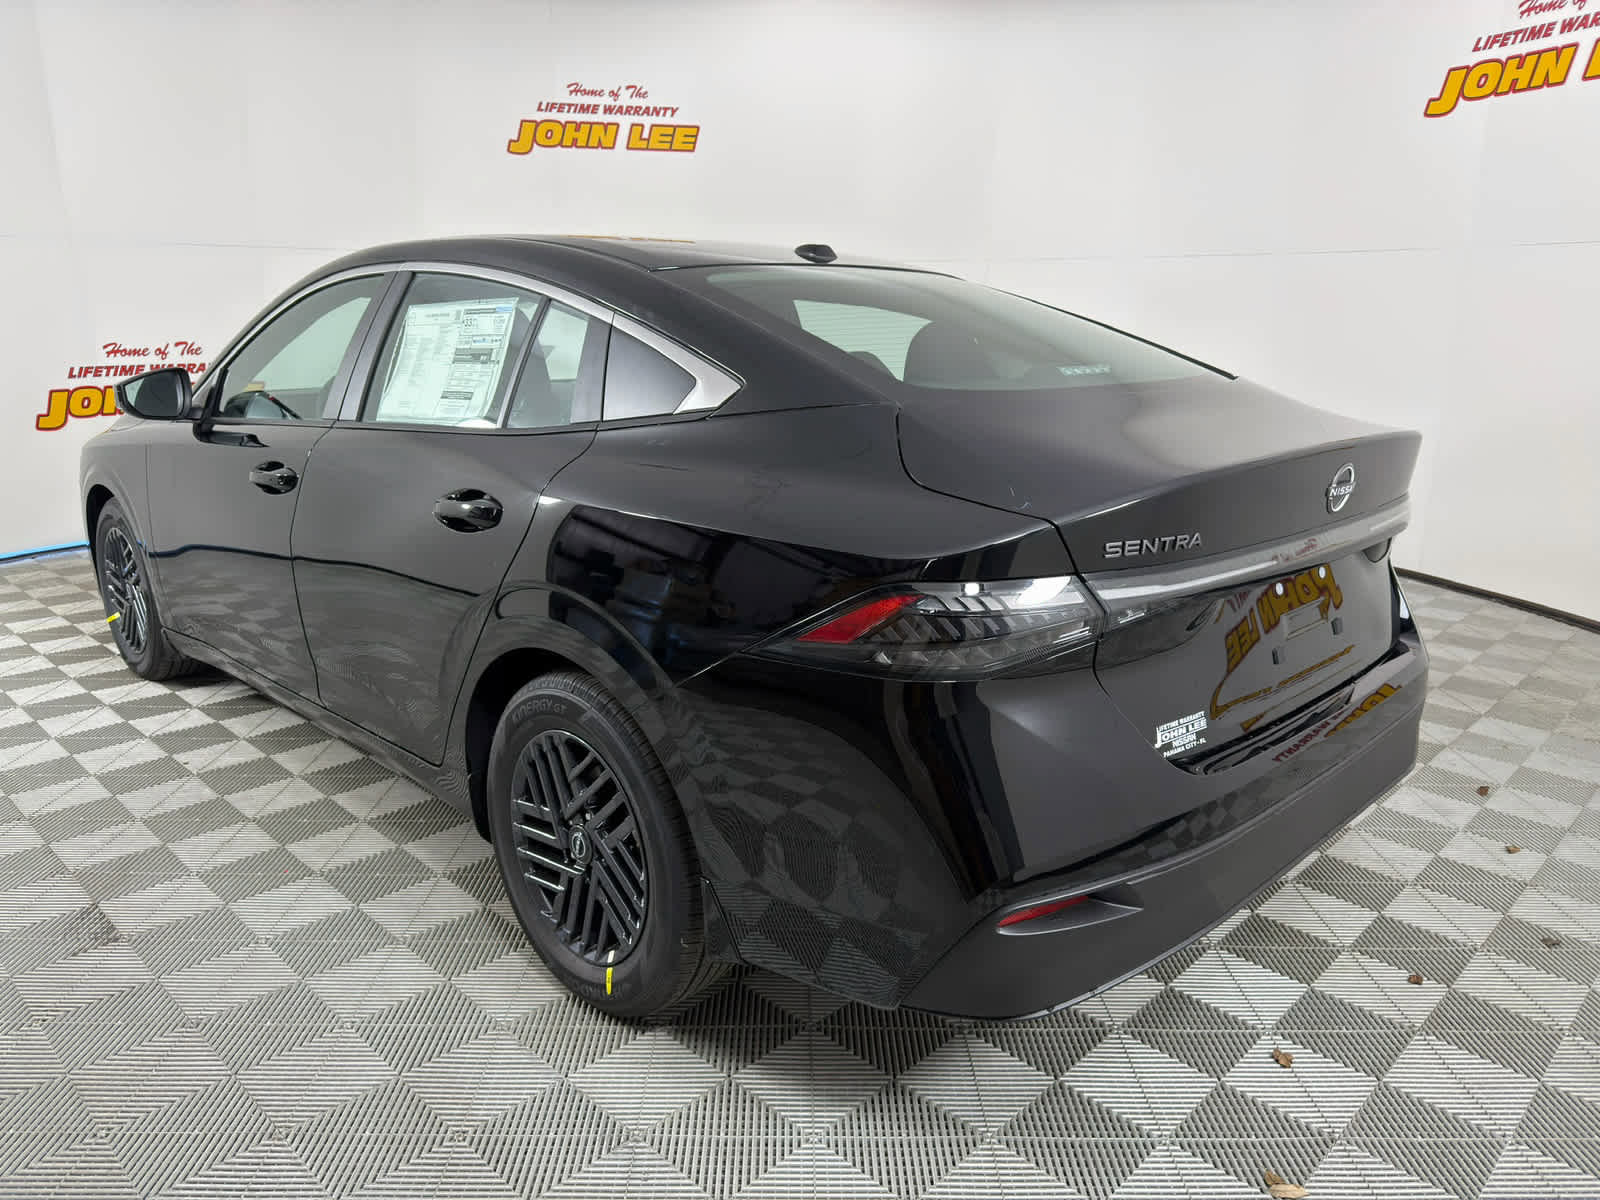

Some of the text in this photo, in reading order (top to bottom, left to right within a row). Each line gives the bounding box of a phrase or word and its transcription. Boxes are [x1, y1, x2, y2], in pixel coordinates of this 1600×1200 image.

[1518, 0, 1568, 19] Home
[1472, 21, 1557, 52] LIFETIME
[1424, 42, 1579, 117] JOHN
[567, 82, 649, 102] Home of The
[536, 101, 679, 118] LIFETIME WARRANTY
[507, 119, 700, 155] JOHN LEE
[102, 341, 203, 360] Home of The
[68, 364, 146, 379] LIFETIME
[1103, 532, 1202, 559] SENTRA
[1154, 718, 1207, 748] JOHN LEE
